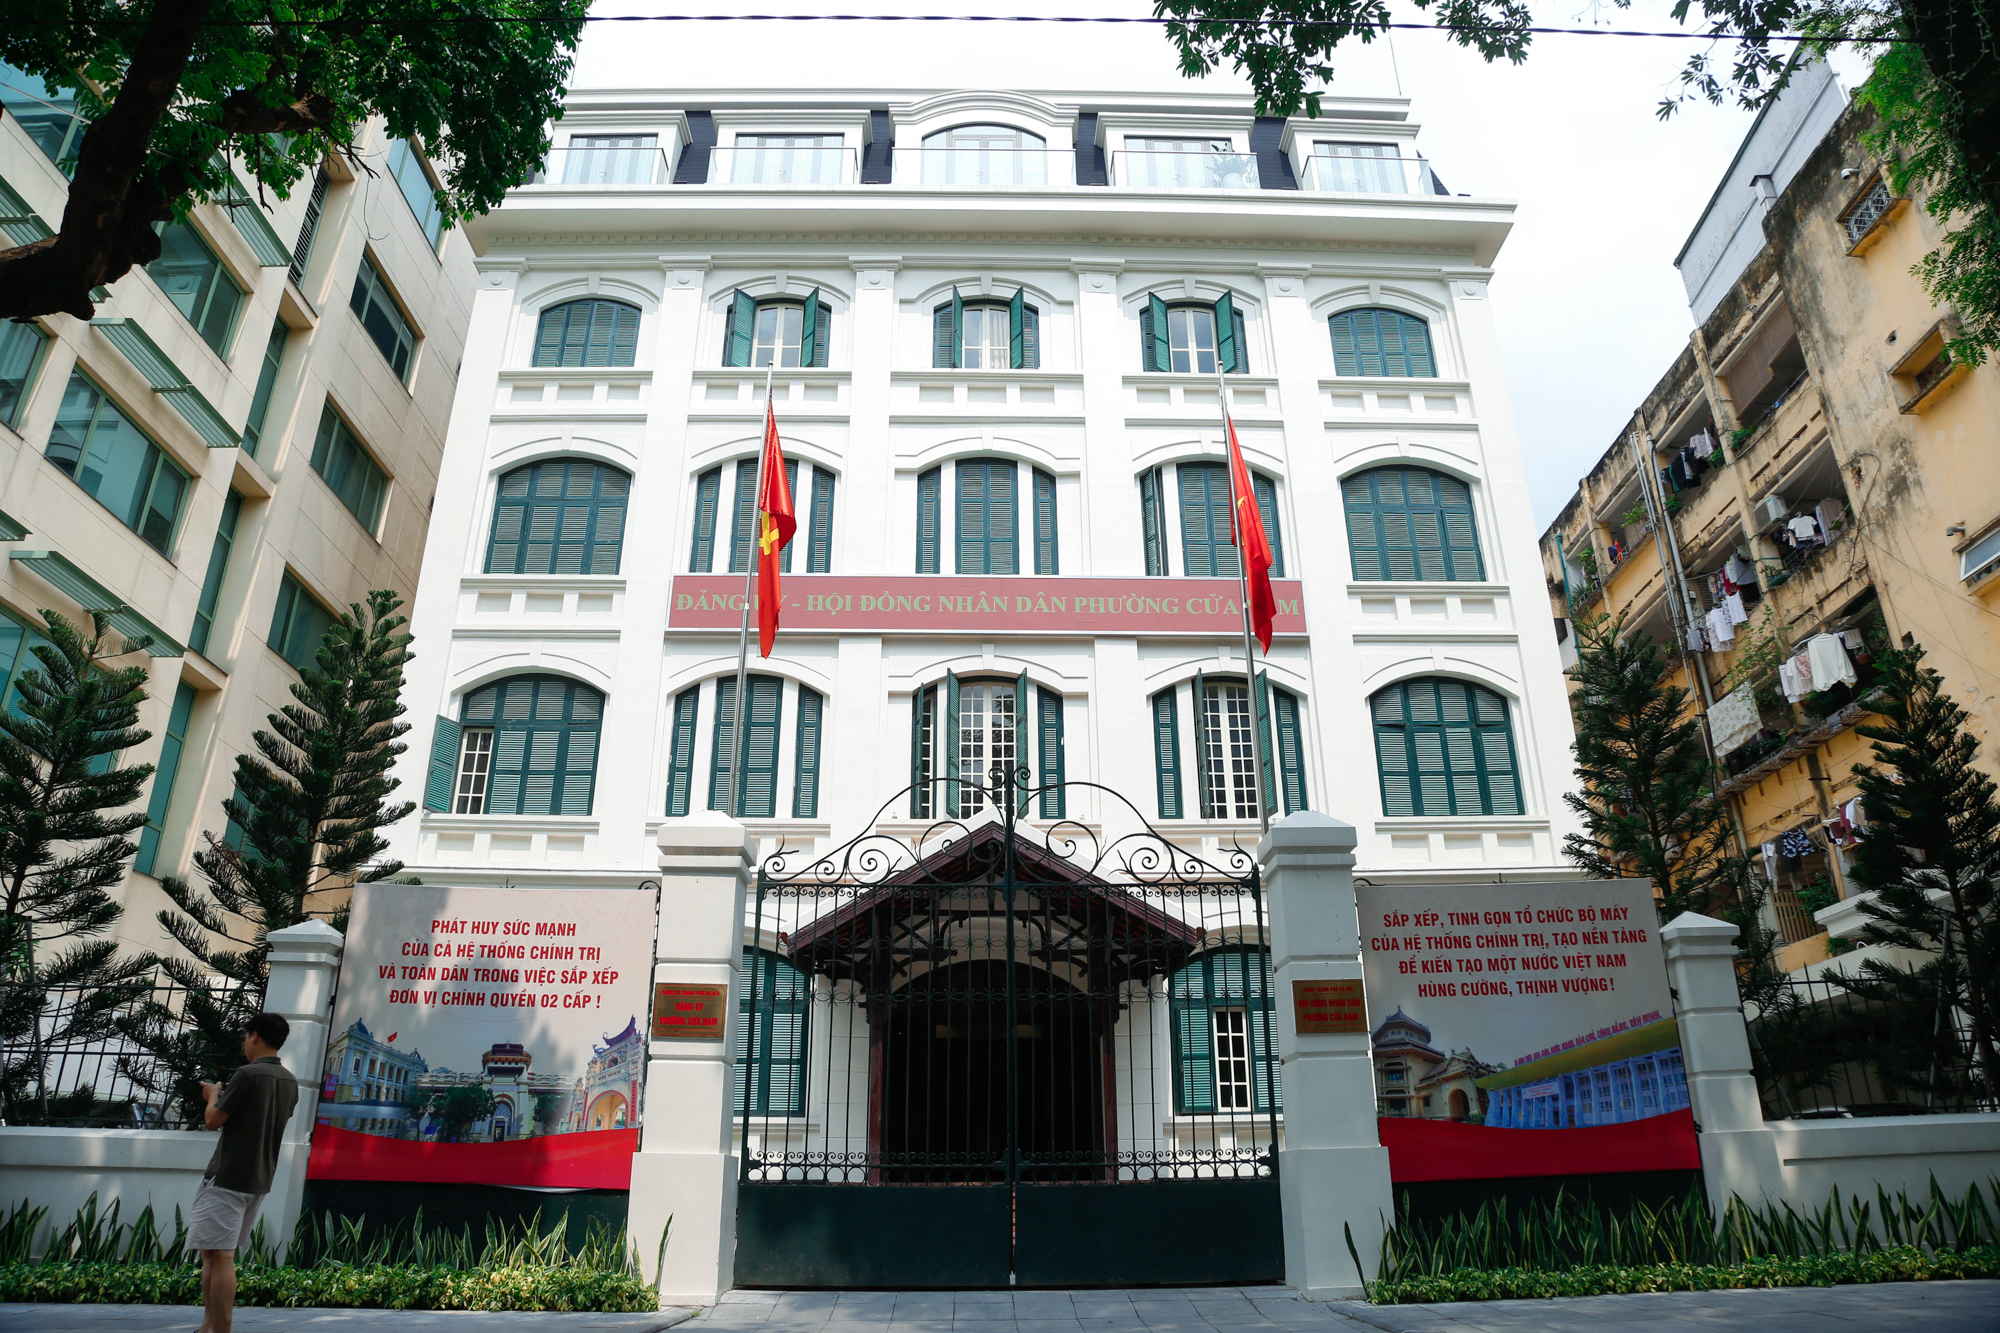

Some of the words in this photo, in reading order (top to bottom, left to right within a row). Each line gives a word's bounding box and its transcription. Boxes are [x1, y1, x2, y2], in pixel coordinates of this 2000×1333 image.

[676, 589, 747, 611] ĐẢNG
[806, 592, 853, 615] HỘI
[859, 590, 932, 612] ĐỒNG
[938, 591, 1009, 613] NHÂN
[1015, 592, 1067, 613] DÂN
[1073, 593, 1180, 614] PHƯỜNG
[1186, 593, 1241, 615] CỬA
[1383, 909, 1410, 928] SẮP
[1413, 908, 1445, 929] XẾP,
[1447, 912, 1480, 926] TINH
[1483, 911, 1512, 928] GỌN
[1515, 904, 1533, 925] TỔ
[1536, 906, 1574, 924] CHỨC
[1578, 905, 1597, 925] BỘ
[1600, 904, 1629, 921] MÁY
[431, 917, 468, 934] PHÁT
[471, 921, 500, 935] HUY
[502, 918, 531, 936] SỨC
[535, 922, 577, 940] MẠNH
[1371, 933, 1400, 951] CỦA
[1403, 933, 1422, 954] HỆ
[1425, 930, 1472, 950] THỐNG
[1476, 931, 1519, 949] CHÍNH
[1522, 933, 1550, 950] TRỊ,
[1552, 931, 1579, 949] TẠO
[1582, 926, 1609, 945] NỀN
[1611, 926, 1647, 944] TẢNG
[401, 938, 429, 957] CỦA
[433, 940, 452, 957] CẢ
[456, 941, 475, 961] HỆ
[479, 940, 526, 959] THỐNG
[529, 943, 574, 960] CHÍNH
[578, 946, 601, 964] TRỊ
[379, 962, 396, 979] VÀ
[401, 963, 437, 981] TOÀN
[441, 964, 469, 982] DÂN
[473, 967, 520, 983] TRONG
[524, 966, 556, 987] VIỆC
[560, 965, 588, 984] SẮP
[591, 965, 619, 985] XẾP
[1398, 954, 1417, 974] ĐỂ
[1421, 955, 1453, 974] KIẾN
[1456, 958, 1483, 976] TẠO
[1487, 954, 1517, 975] MỘT
[1521, 953, 1559, 971] NƯỚC
[1562, 951, 1592, 972] VIỆT
[1596, 953, 1627, 968] NAM
[389, 988, 419, 1005] ĐƠN
[424, 991, 438, 1008] VỊ
[441, 988, 486, 1007] CHÍNH
[490, 988, 536, 1008] QUYỀN
[540, 994, 559, 1008] 02
[562, 989, 592, 1009] CẤP
[1418, 980, 1457, 998] HÙNG
[1460, 978, 1513, 997] CƯỜNG,
[1516, 979, 1558, 997] THỊNH
[675, 1000, 694, 1011] ĐẢNG
[1329, 997, 1346, 1008] NHÂN
[1348, 996, 1361, 1007] DÂN
[659, 1015, 686, 1026] PHƯỜNG
[687, 1014, 701, 1026] CỬA
[702, 1017, 718, 1026] NAM
[1344, 1012, 1359, 1022] NAM
